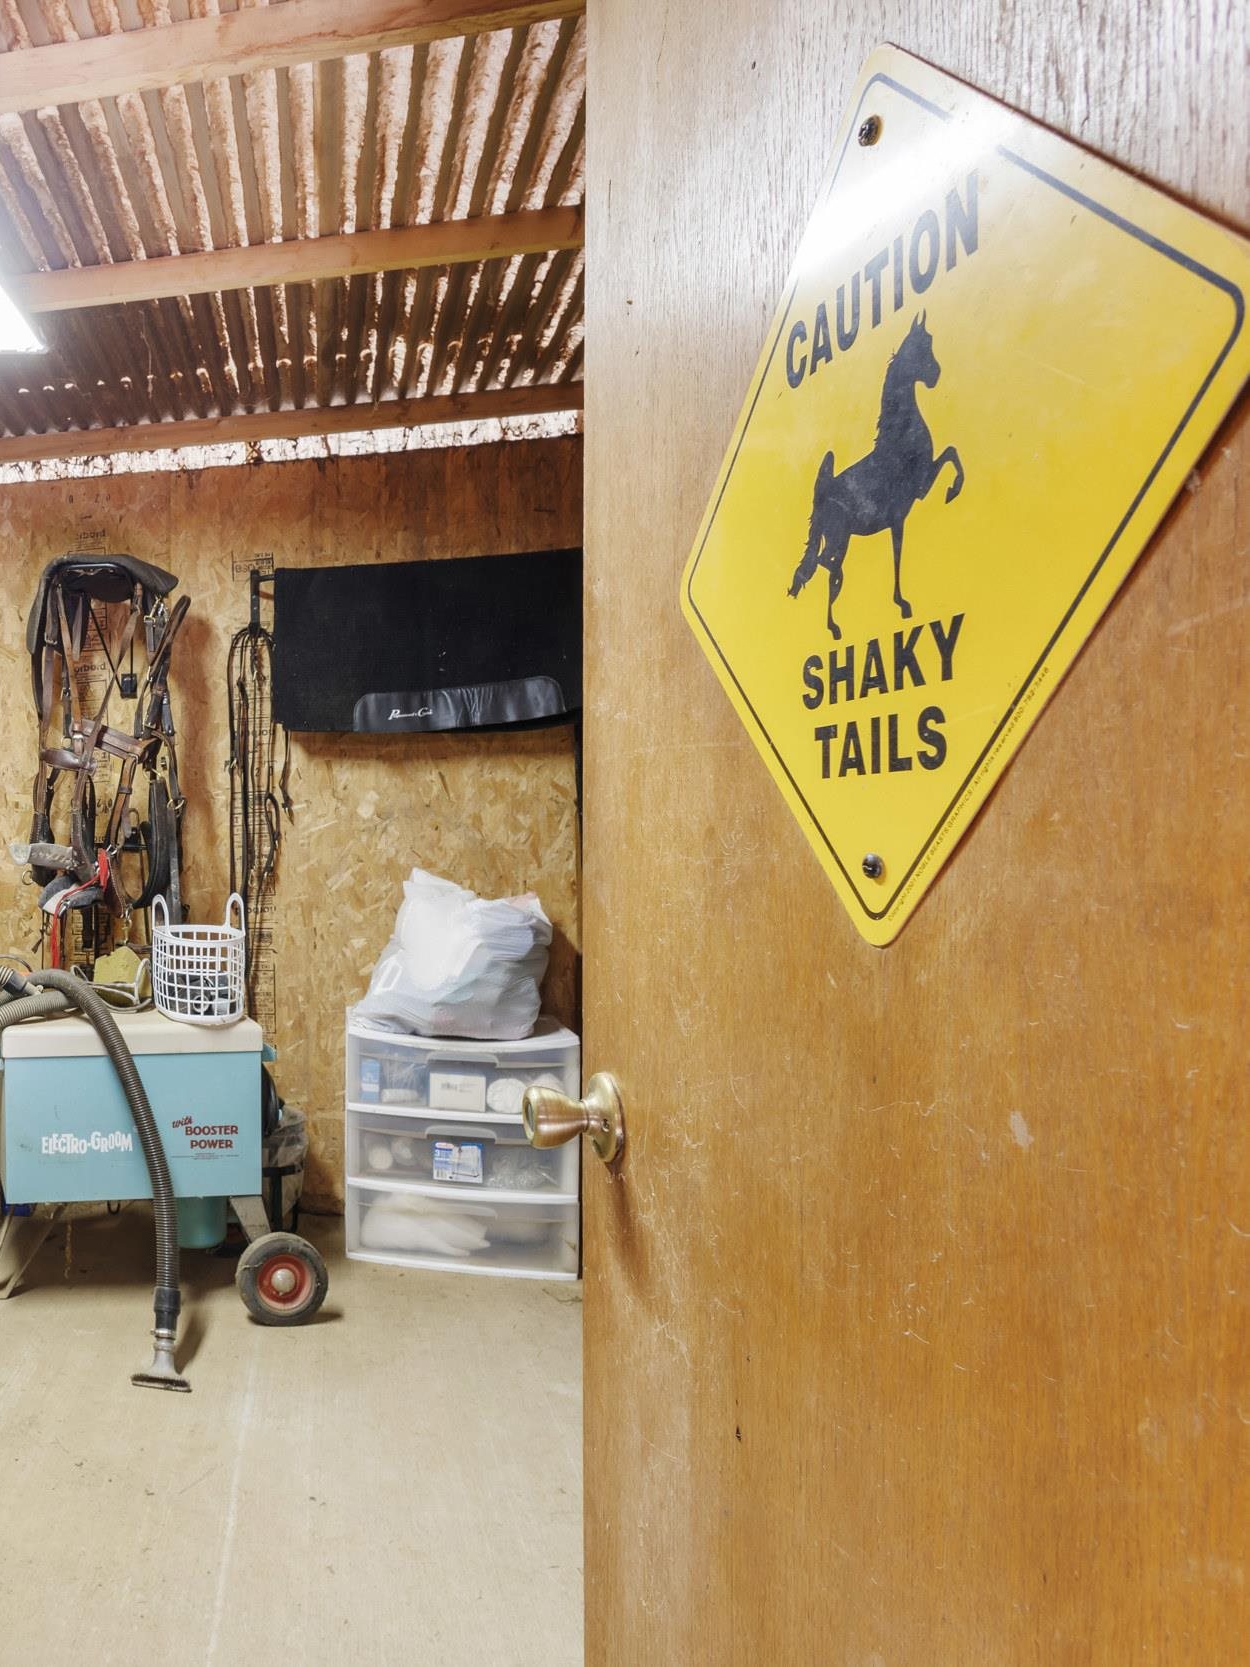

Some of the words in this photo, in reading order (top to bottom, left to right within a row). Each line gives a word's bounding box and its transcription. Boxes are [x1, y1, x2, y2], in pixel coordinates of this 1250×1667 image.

[785, 172, 979, 389] CAUTION
[802, 613, 966, 710] SHAKY
[814, 706, 948, 780] TAILS
[172, 1116, 192, 1128] with
[185, 1125, 238, 1135] BOOSTER
[41, 1131, 133, 1154] ELECTRO-GROOM
[190, 1139, 233, 1149] POWER
